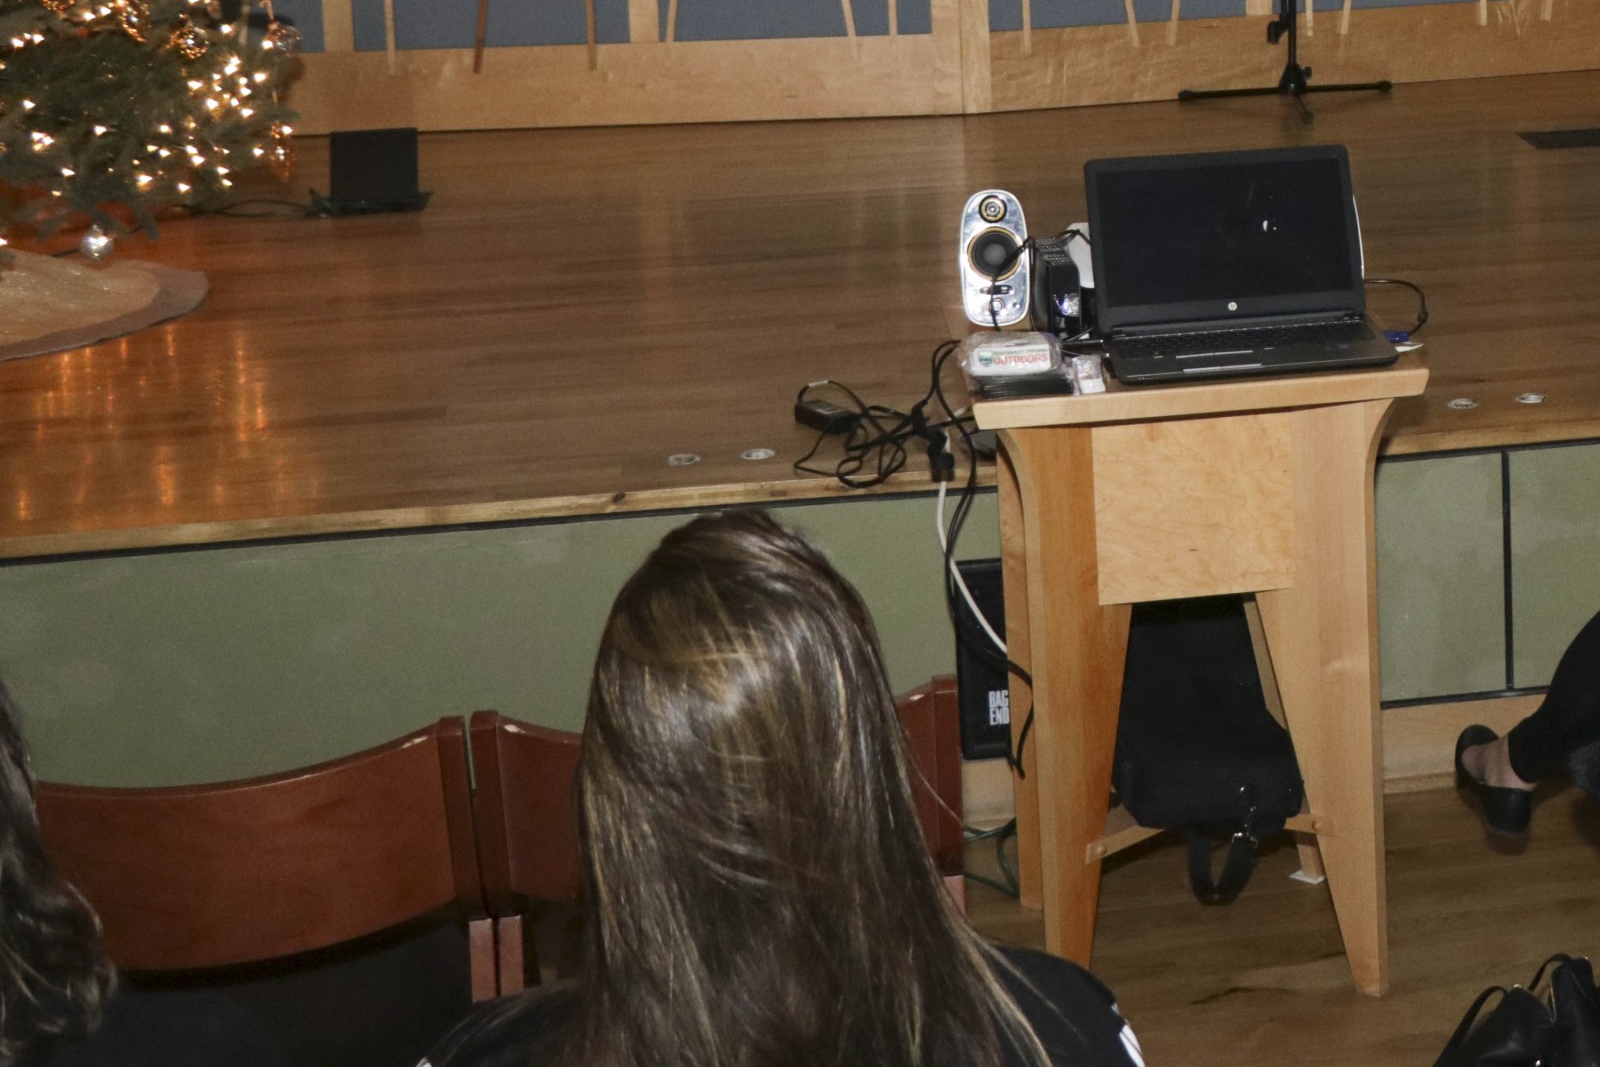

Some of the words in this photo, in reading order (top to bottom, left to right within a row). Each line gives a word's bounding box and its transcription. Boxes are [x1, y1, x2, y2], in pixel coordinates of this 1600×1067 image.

[994, 353, 1048, 366] OUTDOORS
[988, 689, 1009, 708] BAG
[990, 707, 1010, 725] END
